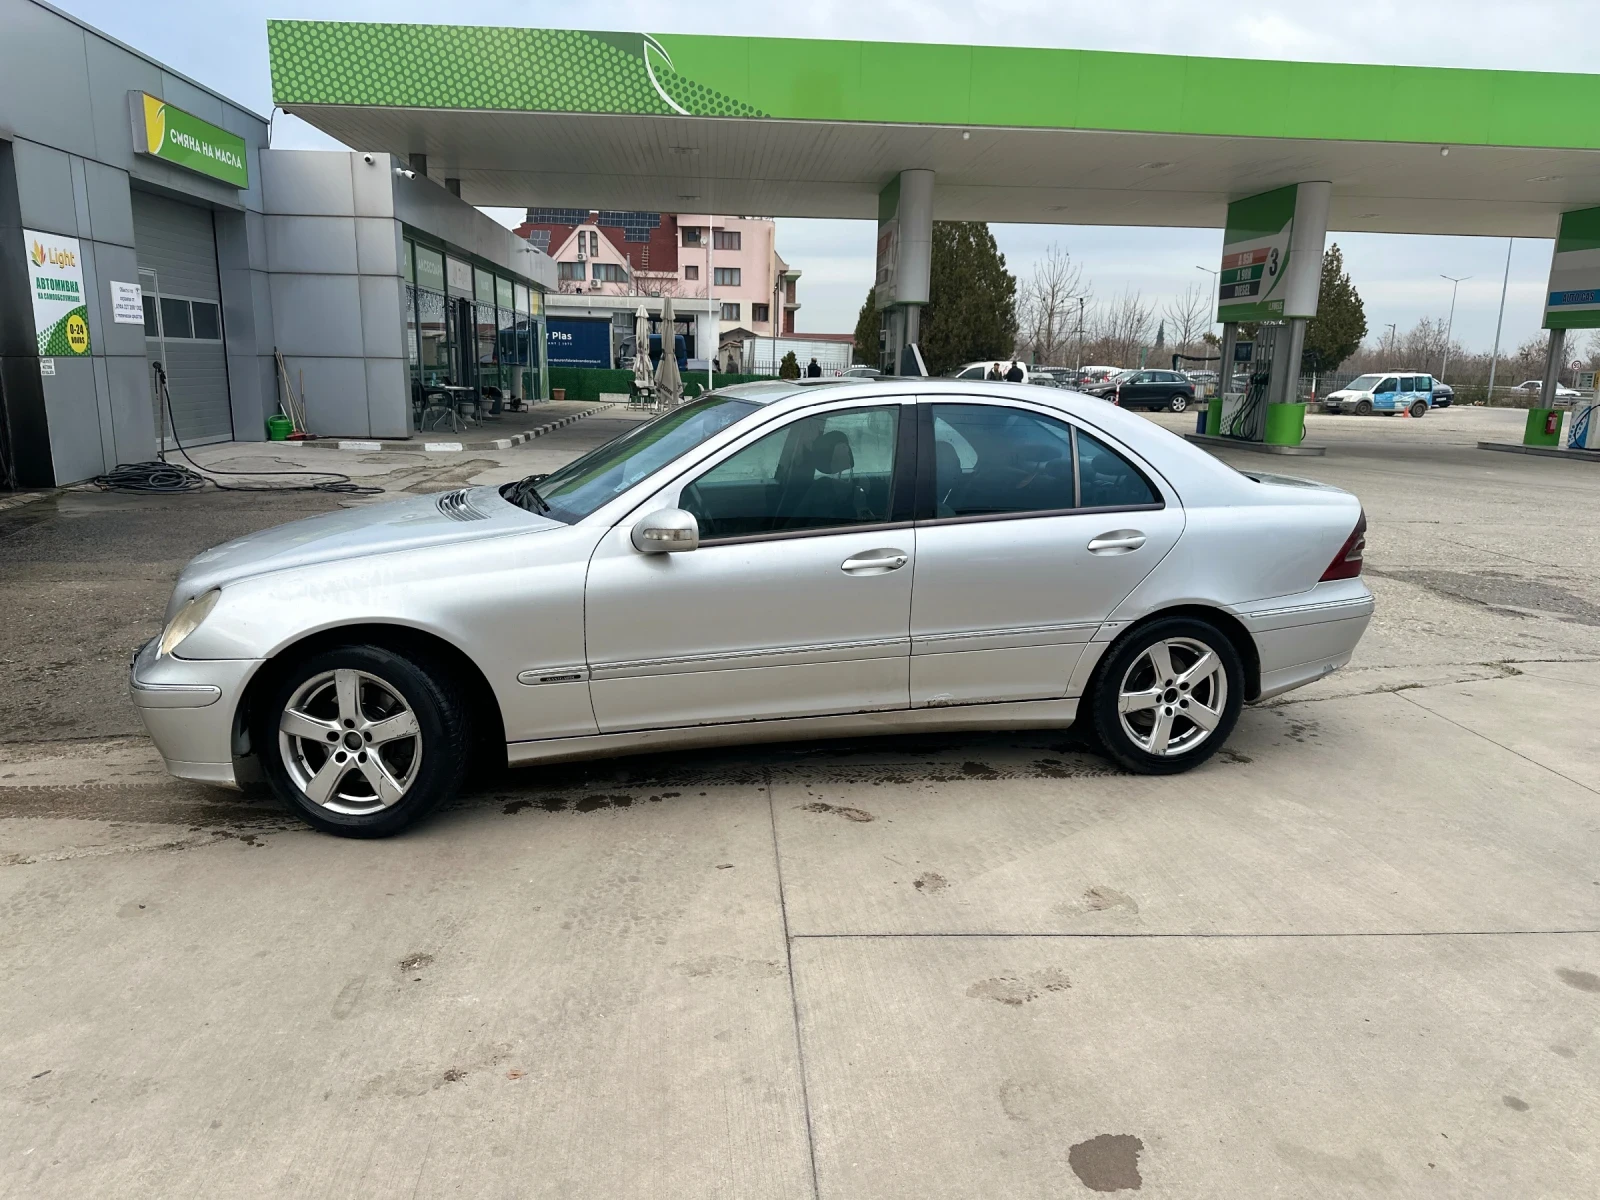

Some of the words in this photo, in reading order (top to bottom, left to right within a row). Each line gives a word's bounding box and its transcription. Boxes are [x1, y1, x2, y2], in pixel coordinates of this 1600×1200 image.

[170, 128, 202, 154] СМЯНА
[202, 140, 215, 159] НА
[215, 146, 243, 169] МАСЛА
[48, 246, 76, 269] Light
[1269, 248, 1278, 276] 3
[36, 277, 79, 293] АВТОМИВКА
[1235, 284, 1250, 296] DIESEL
[69, 323, 84, 335] 0-24
[552, 331, 573, 340] Plas
